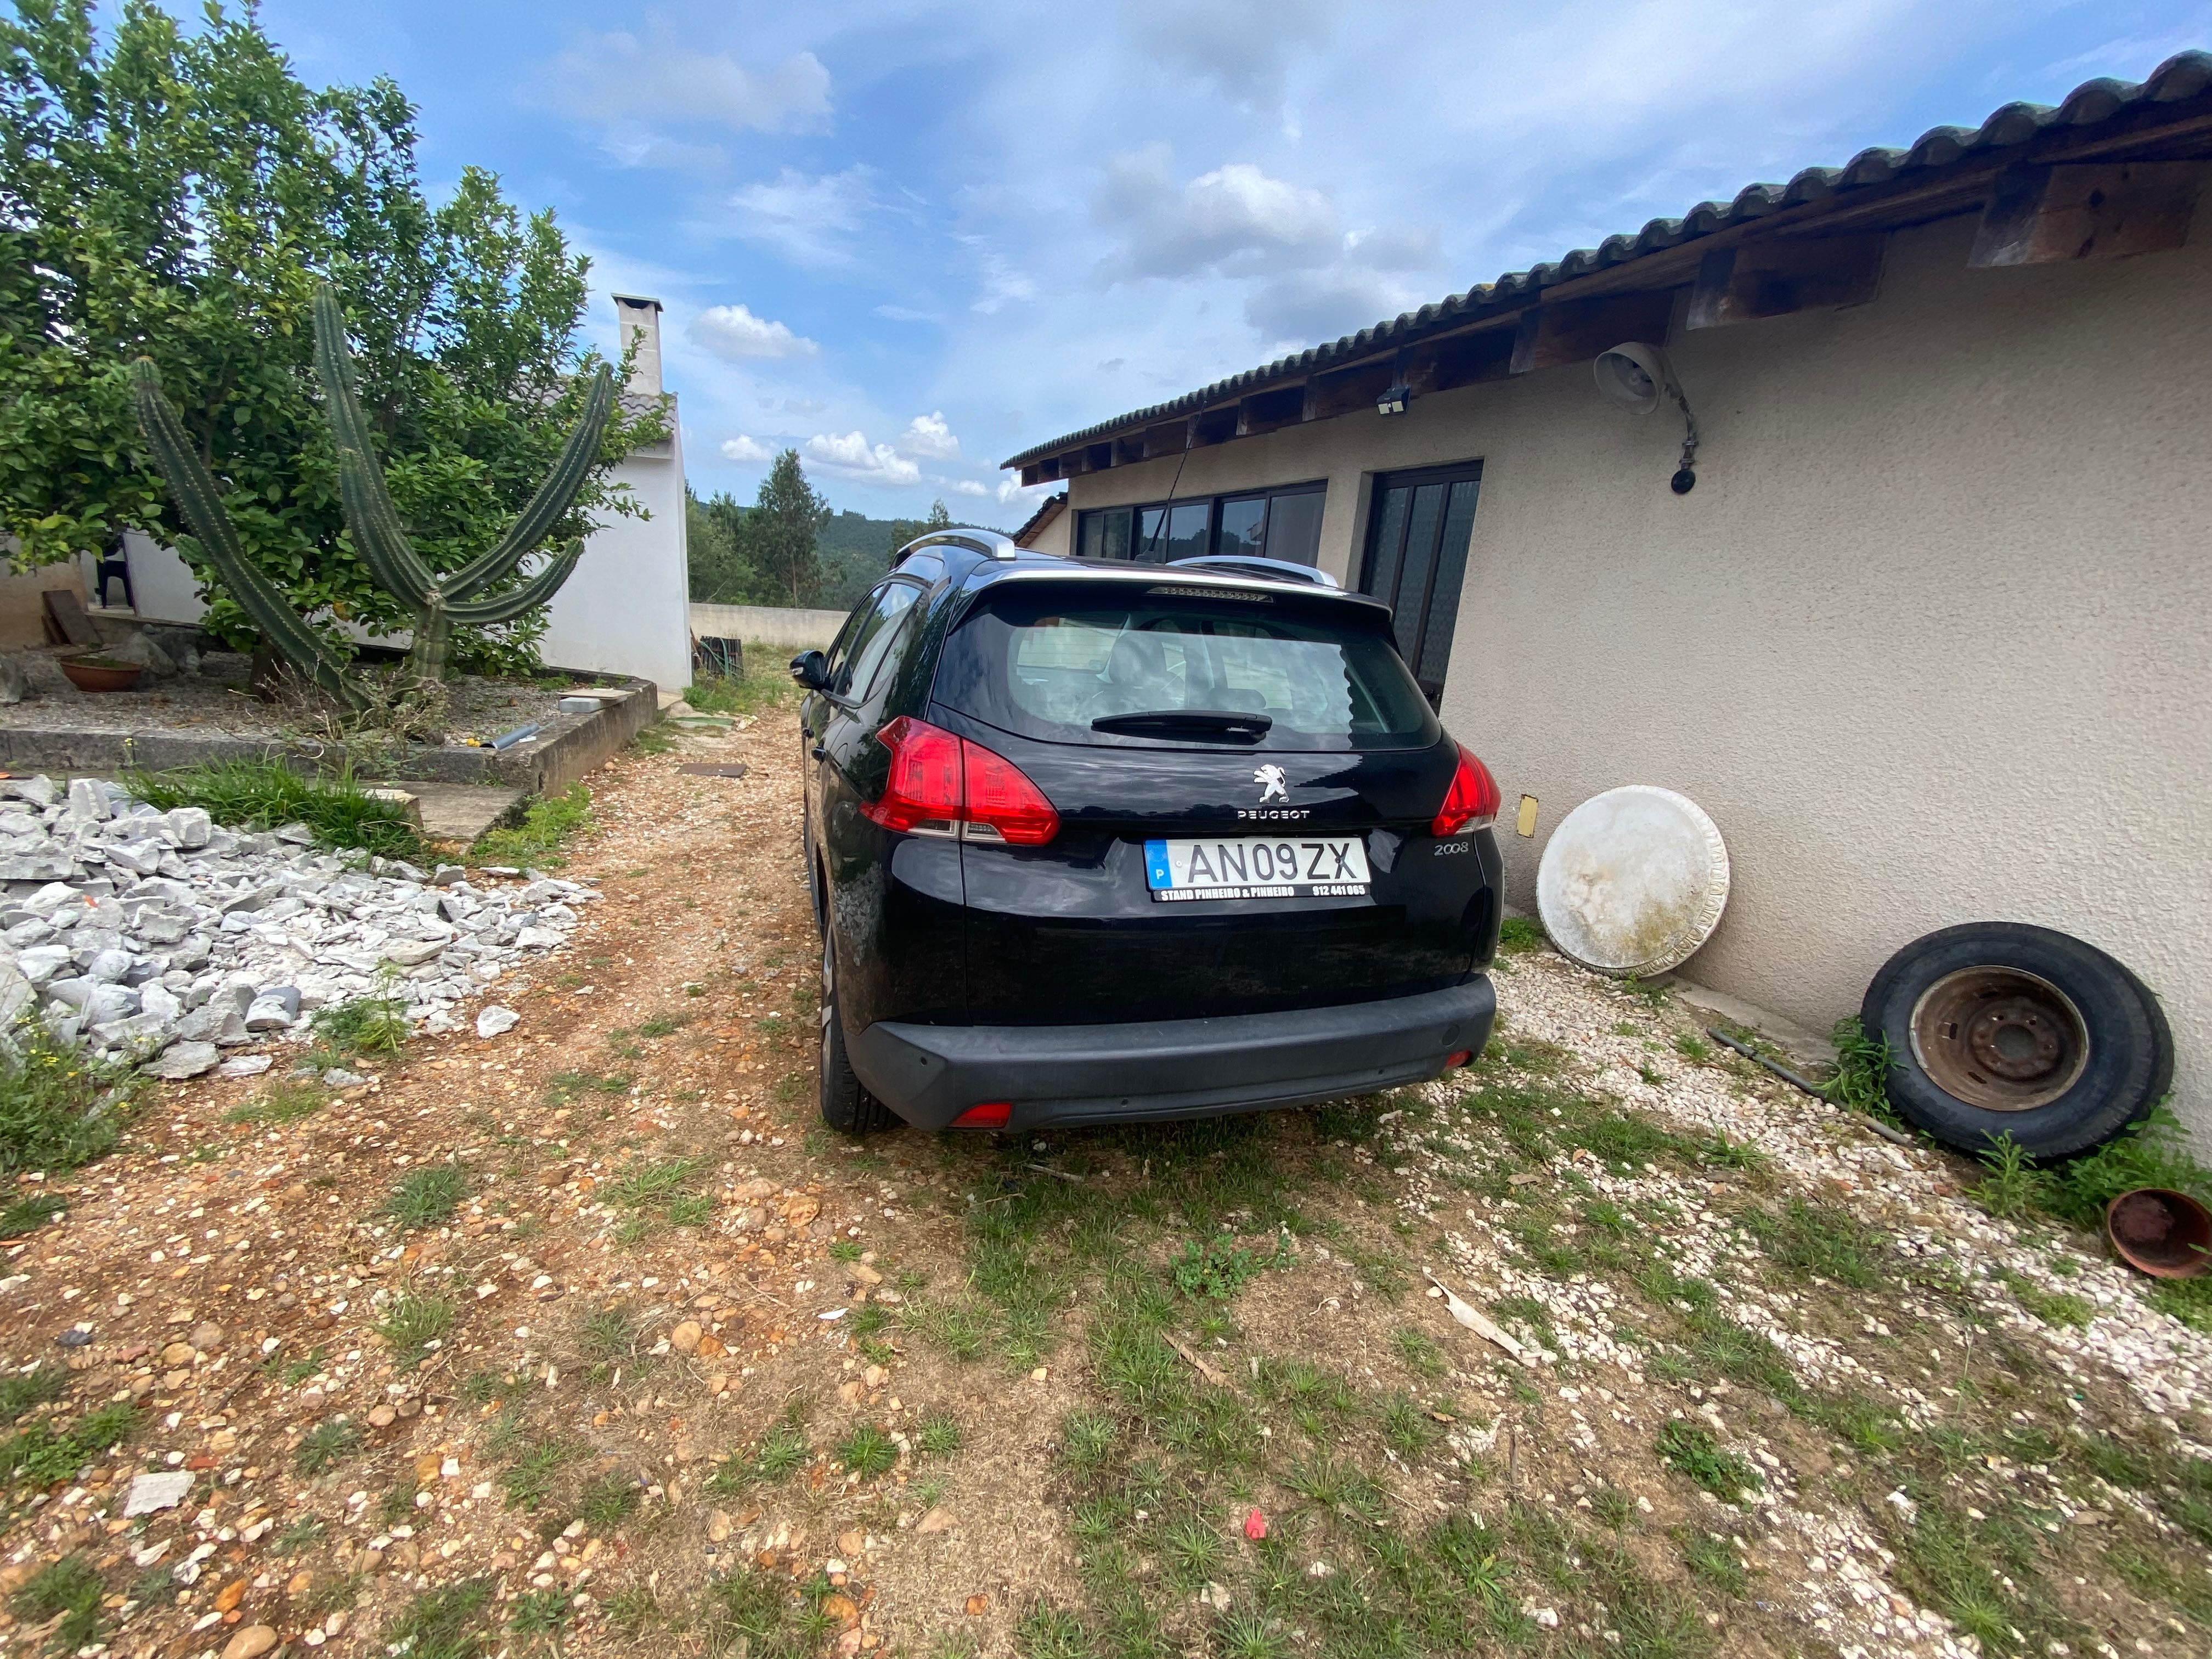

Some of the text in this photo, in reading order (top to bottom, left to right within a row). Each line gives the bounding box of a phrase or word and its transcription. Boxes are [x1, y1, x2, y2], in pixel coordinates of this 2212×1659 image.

[1238, 810, 1310, 819] PEUGEOT
[1434, 842, 1469, 856] 2008
[1155, 869, 1164, 879] P
[1160, 886, 1294, 901] STAND PINHEIRO & PINHEIRO
[1312, 885, 1329, 896] 912
